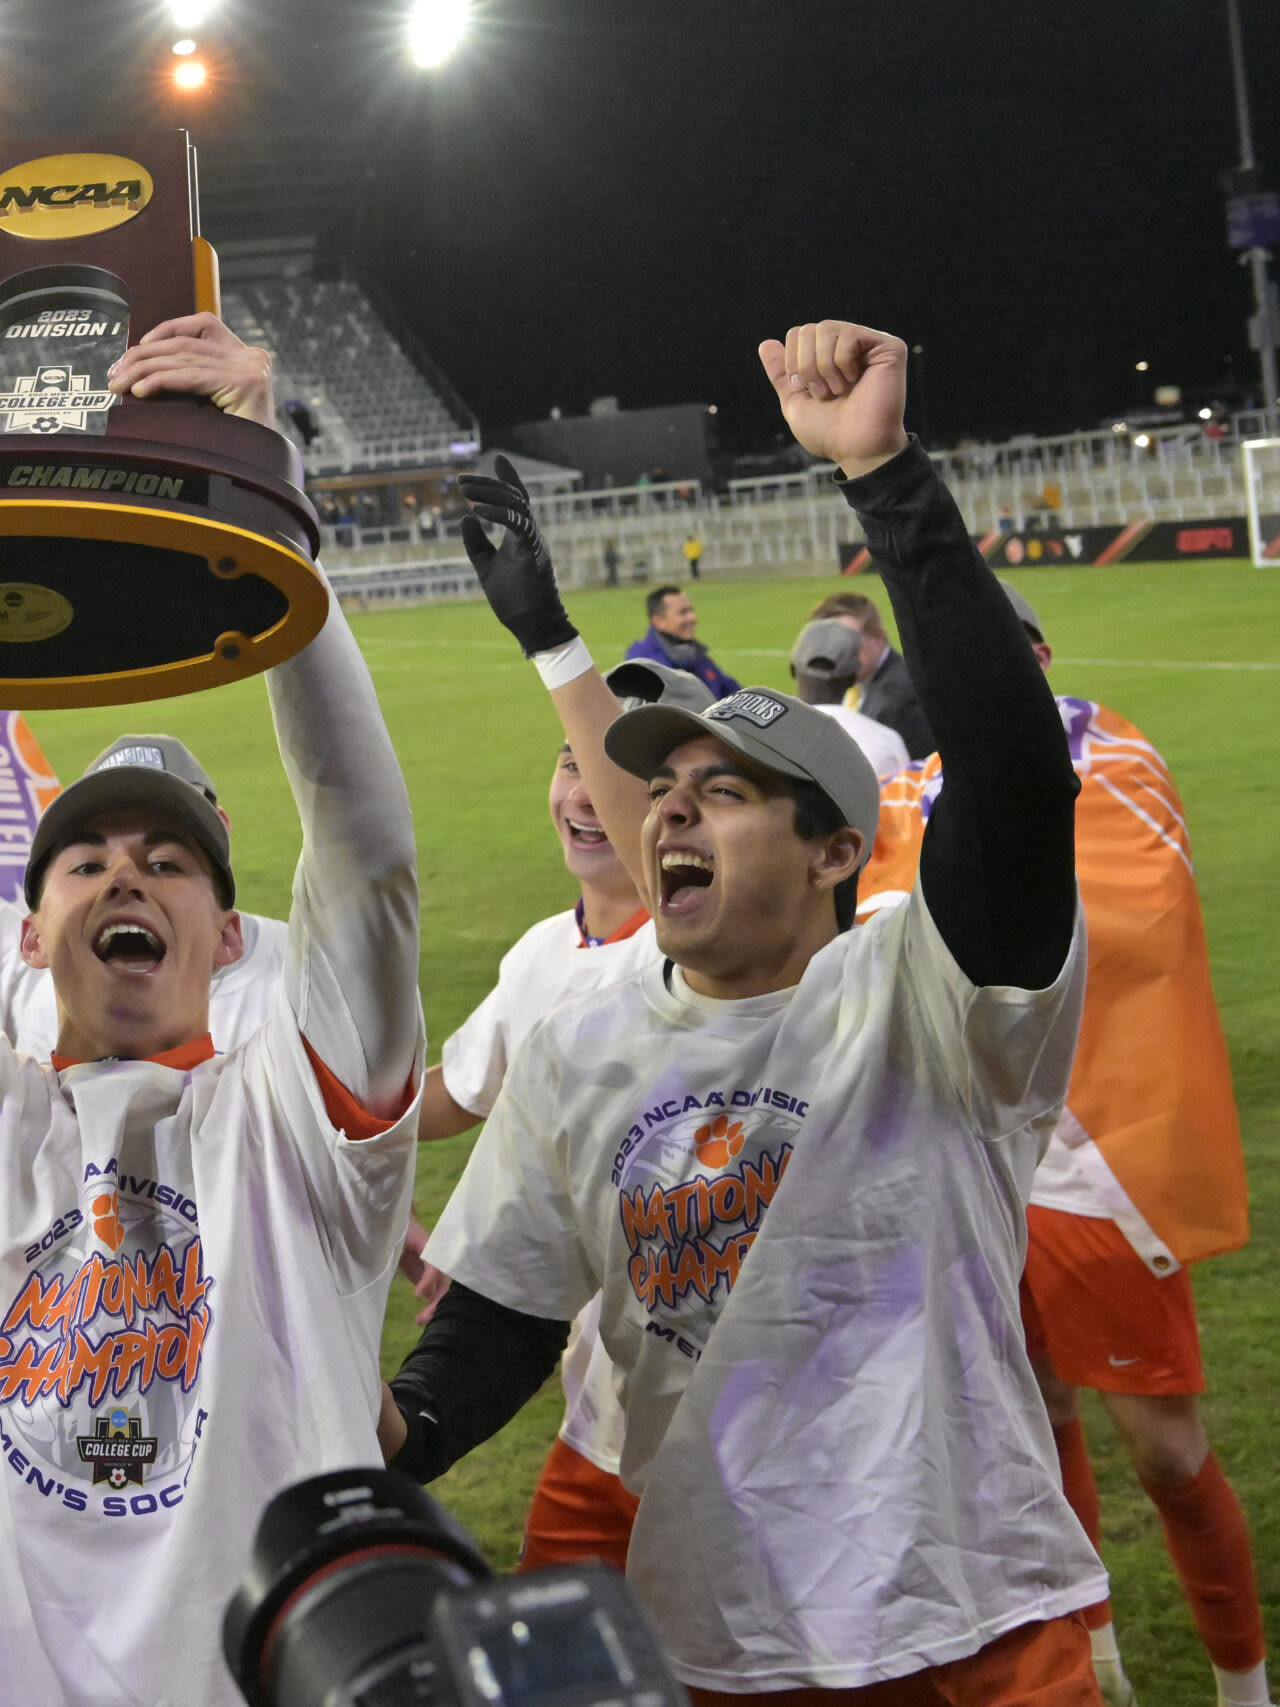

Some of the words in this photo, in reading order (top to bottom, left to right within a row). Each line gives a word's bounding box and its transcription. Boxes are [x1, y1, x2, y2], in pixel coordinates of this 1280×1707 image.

[38, 310, 93, 323] 2023
[5, 323, 108, 339] DIVISION
[112, 322, 122, 336] I
[70, 396, 107, 407] CUP
[7, 466, 184, 499] CHAMPION
[611, 1124, 645, 1188] 2023
[642, 1091, 726, 1129] NCAA
[24, 1208, 84, 1263] 2023
[85, 1443, 130, 1457] COLLEGE
[132, 1444, 153, 1457] CUP
